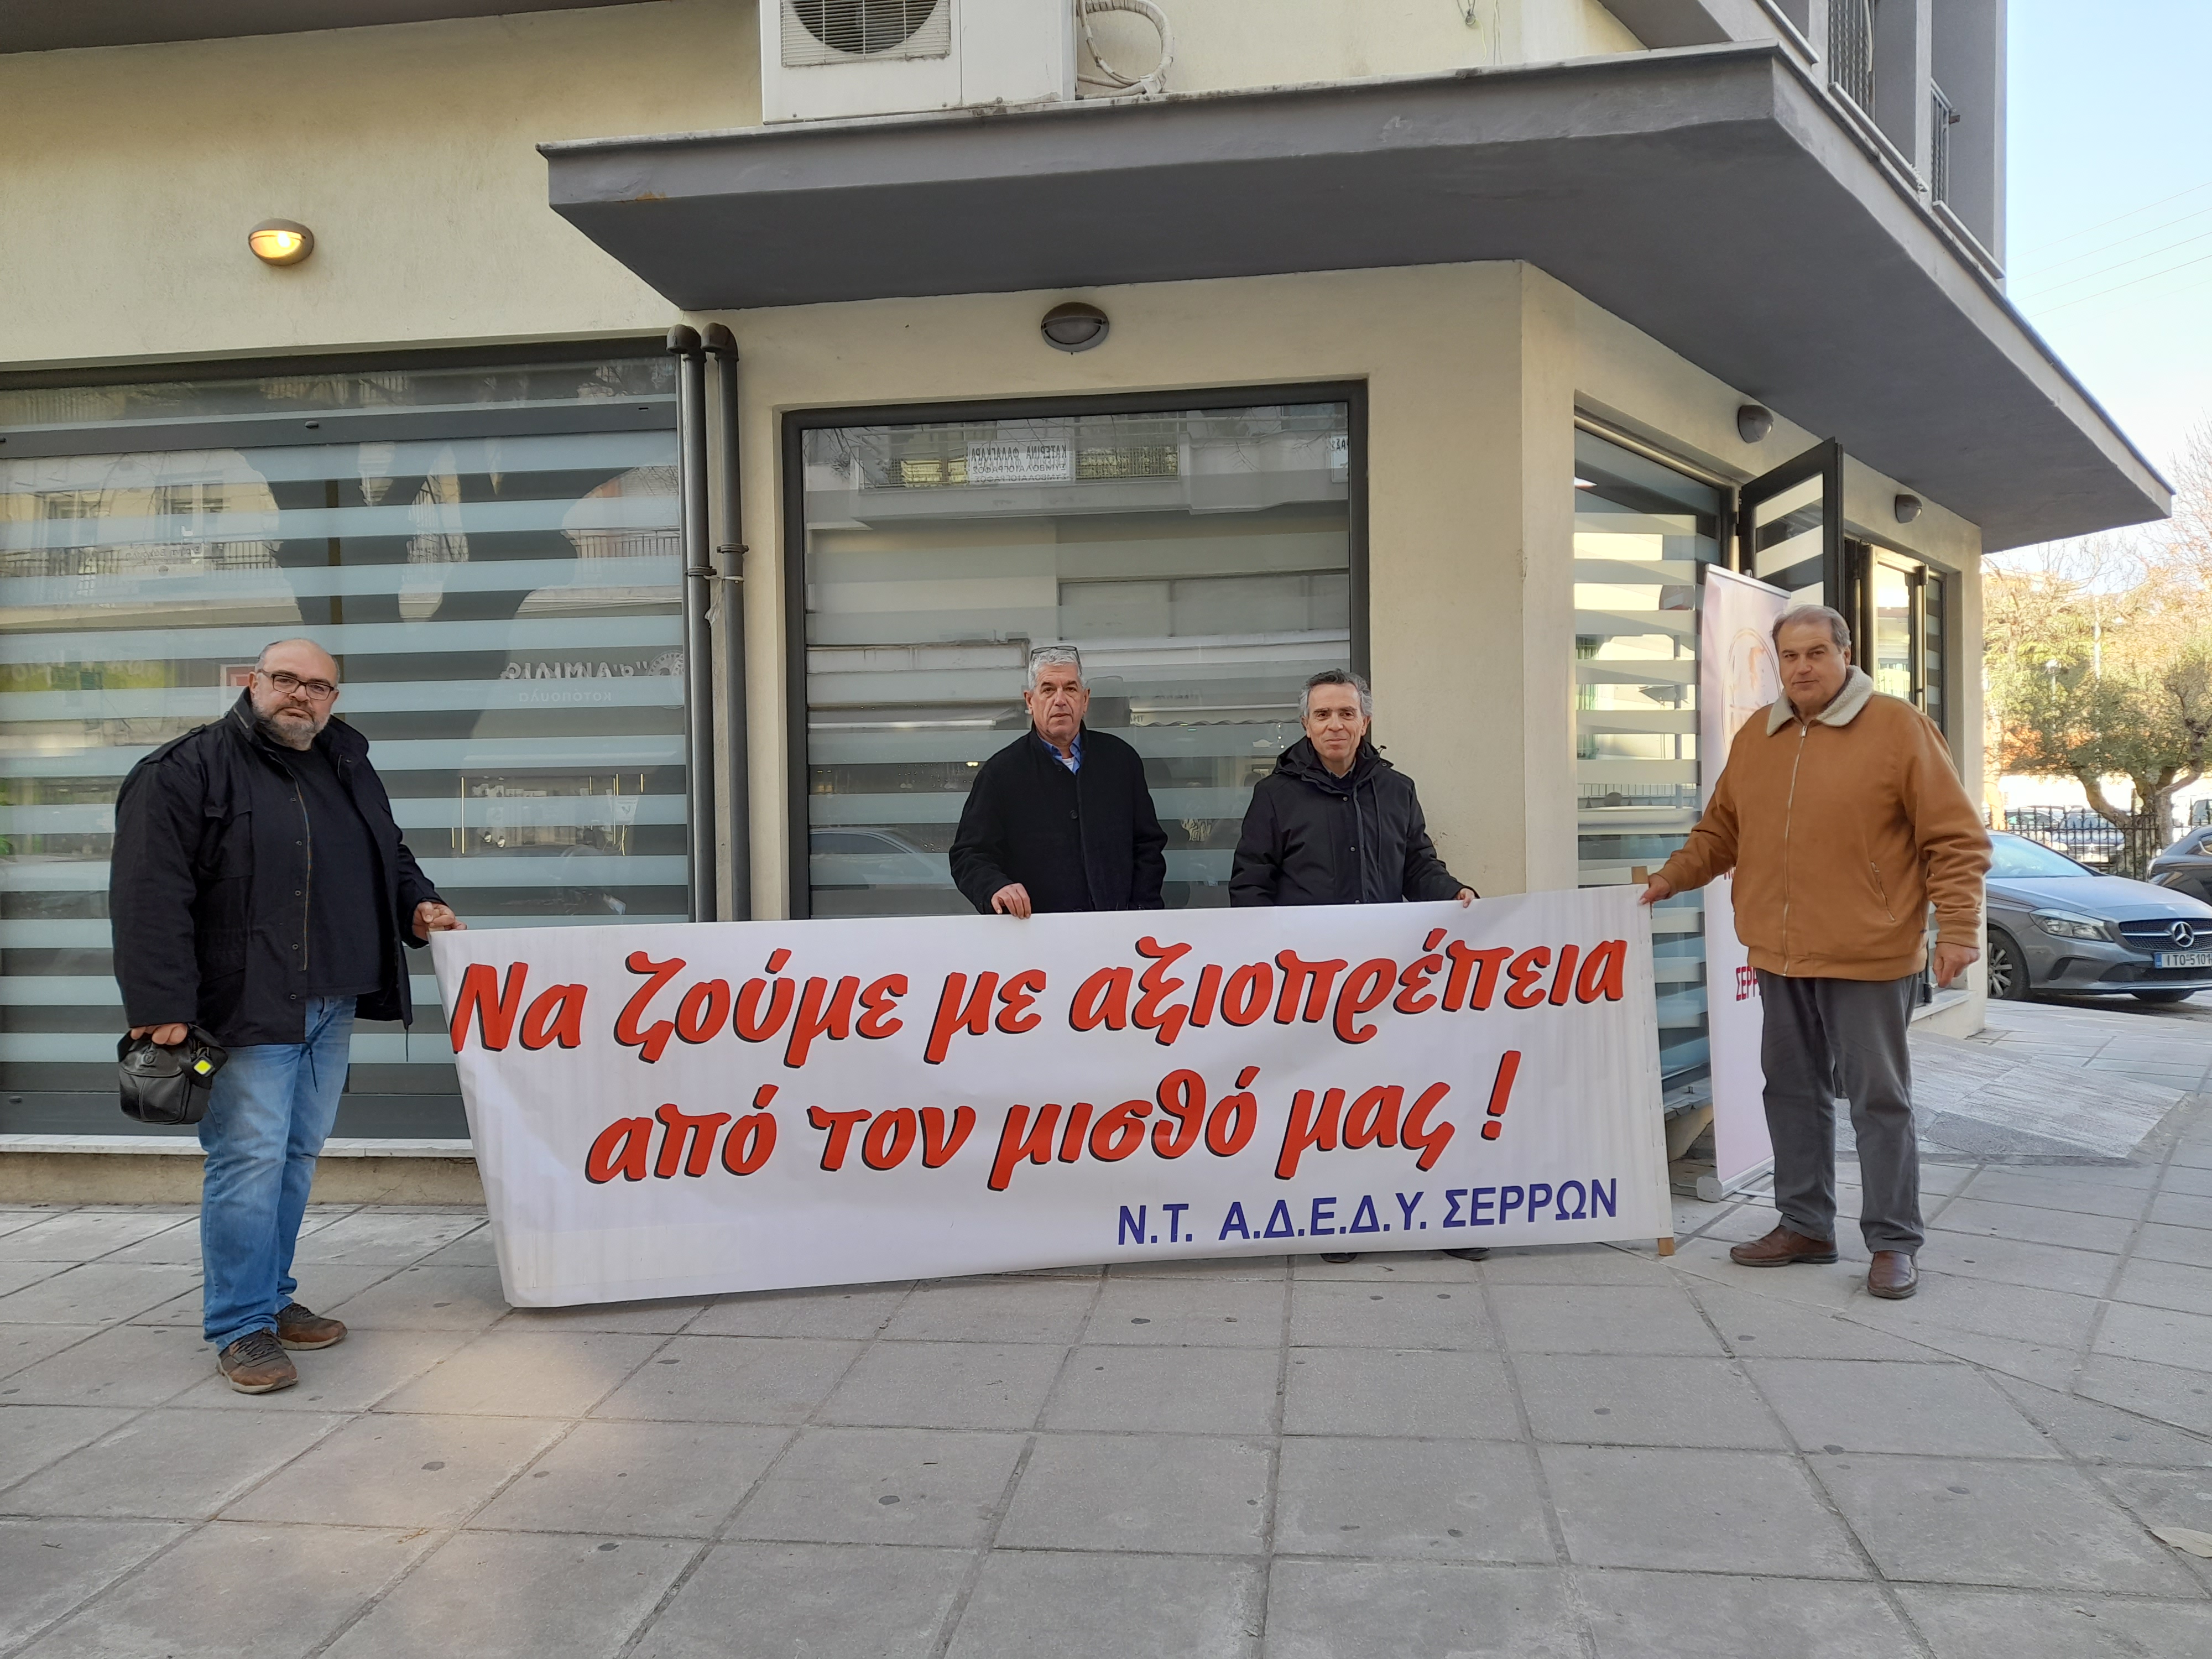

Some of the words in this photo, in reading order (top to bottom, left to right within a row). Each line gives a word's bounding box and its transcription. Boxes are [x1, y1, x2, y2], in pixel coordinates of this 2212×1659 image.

[450, 961, 588, 1054] Να
[614, 948, 909, 1068] ζούμε
[924, 969, 1047, 1065] με
[1068, 927, 1628, 1047] αξιοπρέπεια
[1736, 966, 1761, 1001] ΣΕΡΡ
[585, 1083, 779, 1184] από
[807, 1105, 977, 1171] τον
[987, 1066, 1261, 1192] μισθό
[1274, 1081, 1456, 1181] μας
[1118, 1203, 1193, 1245] Ν.Τ.
[1218, 1191, 1427, 1241] Α.Δ.Ε.Δ.Υ.
[1442, 1177, 1618, 1229] ΣΕΡΡΩΝ
